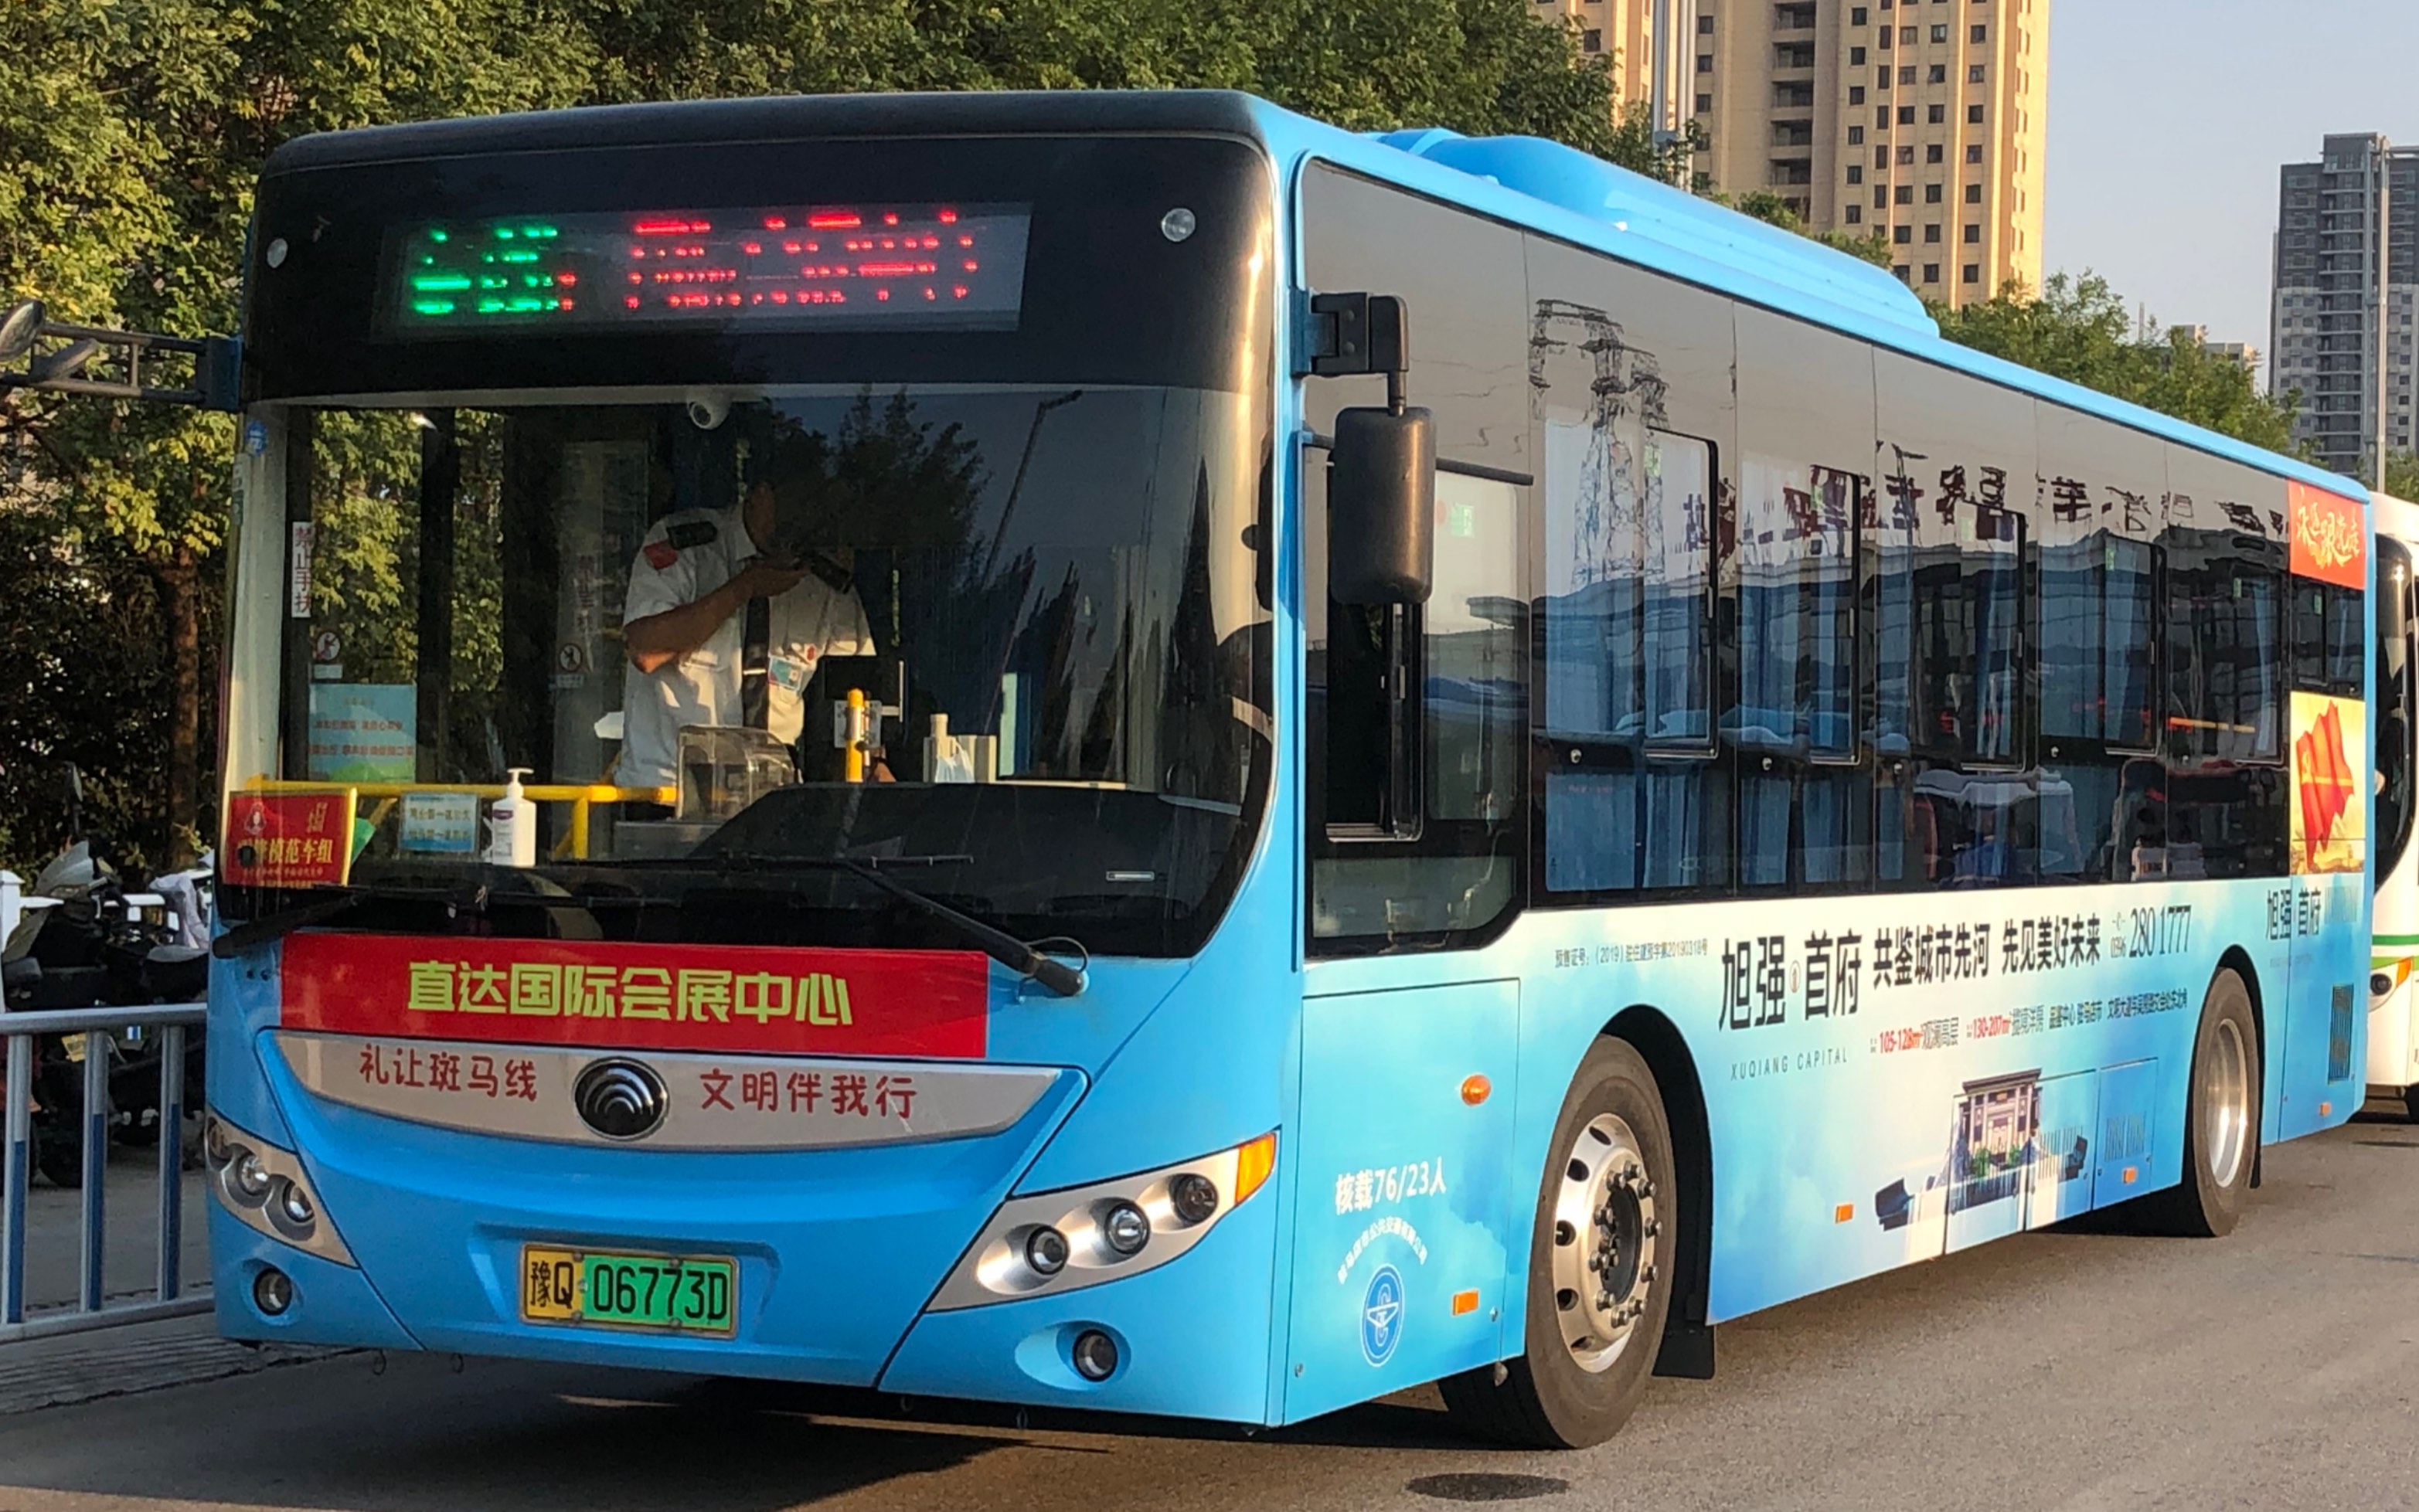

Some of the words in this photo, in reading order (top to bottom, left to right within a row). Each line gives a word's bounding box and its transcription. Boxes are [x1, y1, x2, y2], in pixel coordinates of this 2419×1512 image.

[1873, 924, 1990, 989] 共鉴城市先河
[2002, 913, 2101, 975] 先见美好未来
[407, 960, 852, 1026] 直达国际会展中心
[359, 1044, 538, 1102] 礼让斑马线
[1730, 1055, 1788, 1081] XUQIANG
[1797, 1047, 1848, 1073] CAPITAL
[700, 1069, 917, 1120] 文明伴我行
[1335, 1157, 1446, 1215] 核载76/23人
